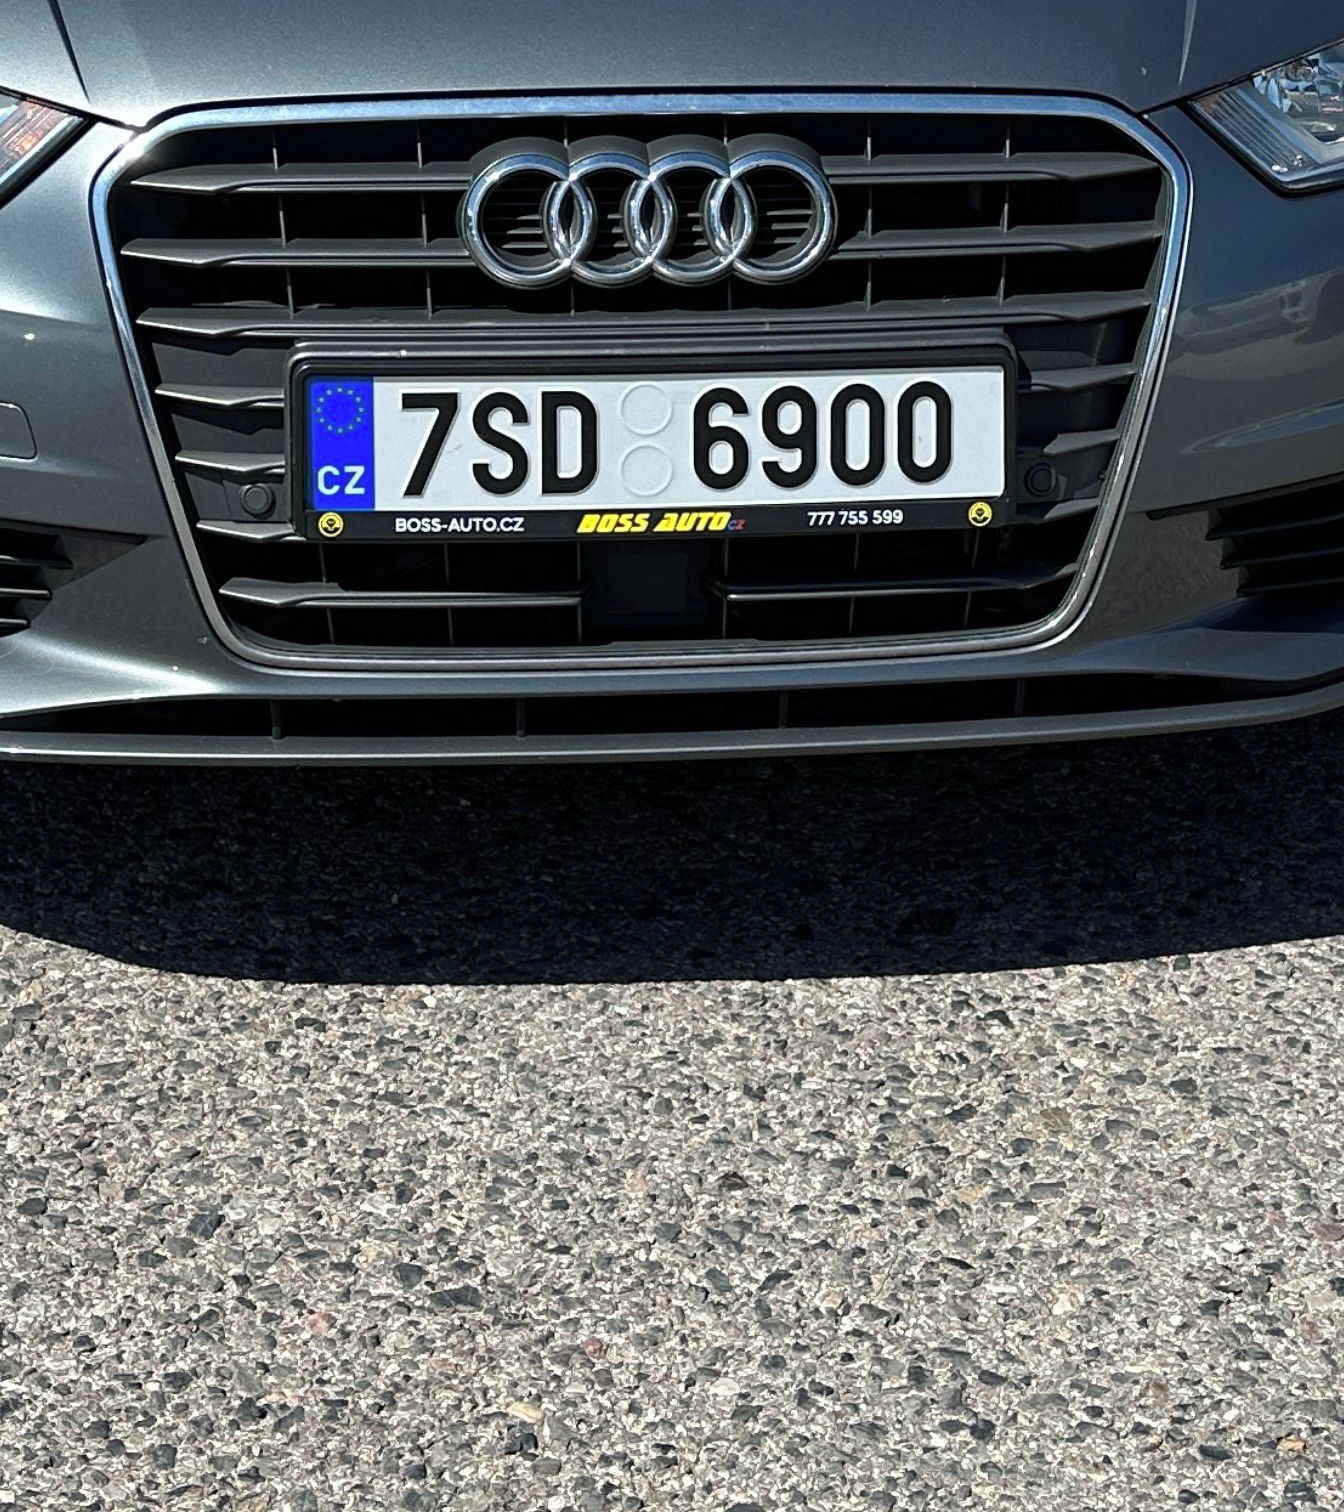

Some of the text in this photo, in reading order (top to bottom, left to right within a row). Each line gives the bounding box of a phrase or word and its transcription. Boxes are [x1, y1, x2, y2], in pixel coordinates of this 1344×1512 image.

[401, 380, 952, 497] 7SD 6900
[317, 465, 365, 495] CZ
[394, 517, 525, 533] BOSS-AUTO.CZ
[576, 513, 651, 533] BOSS
[653, 511, 732, 532] AUTO
[807, 509, 905, 526] 777 755 599
